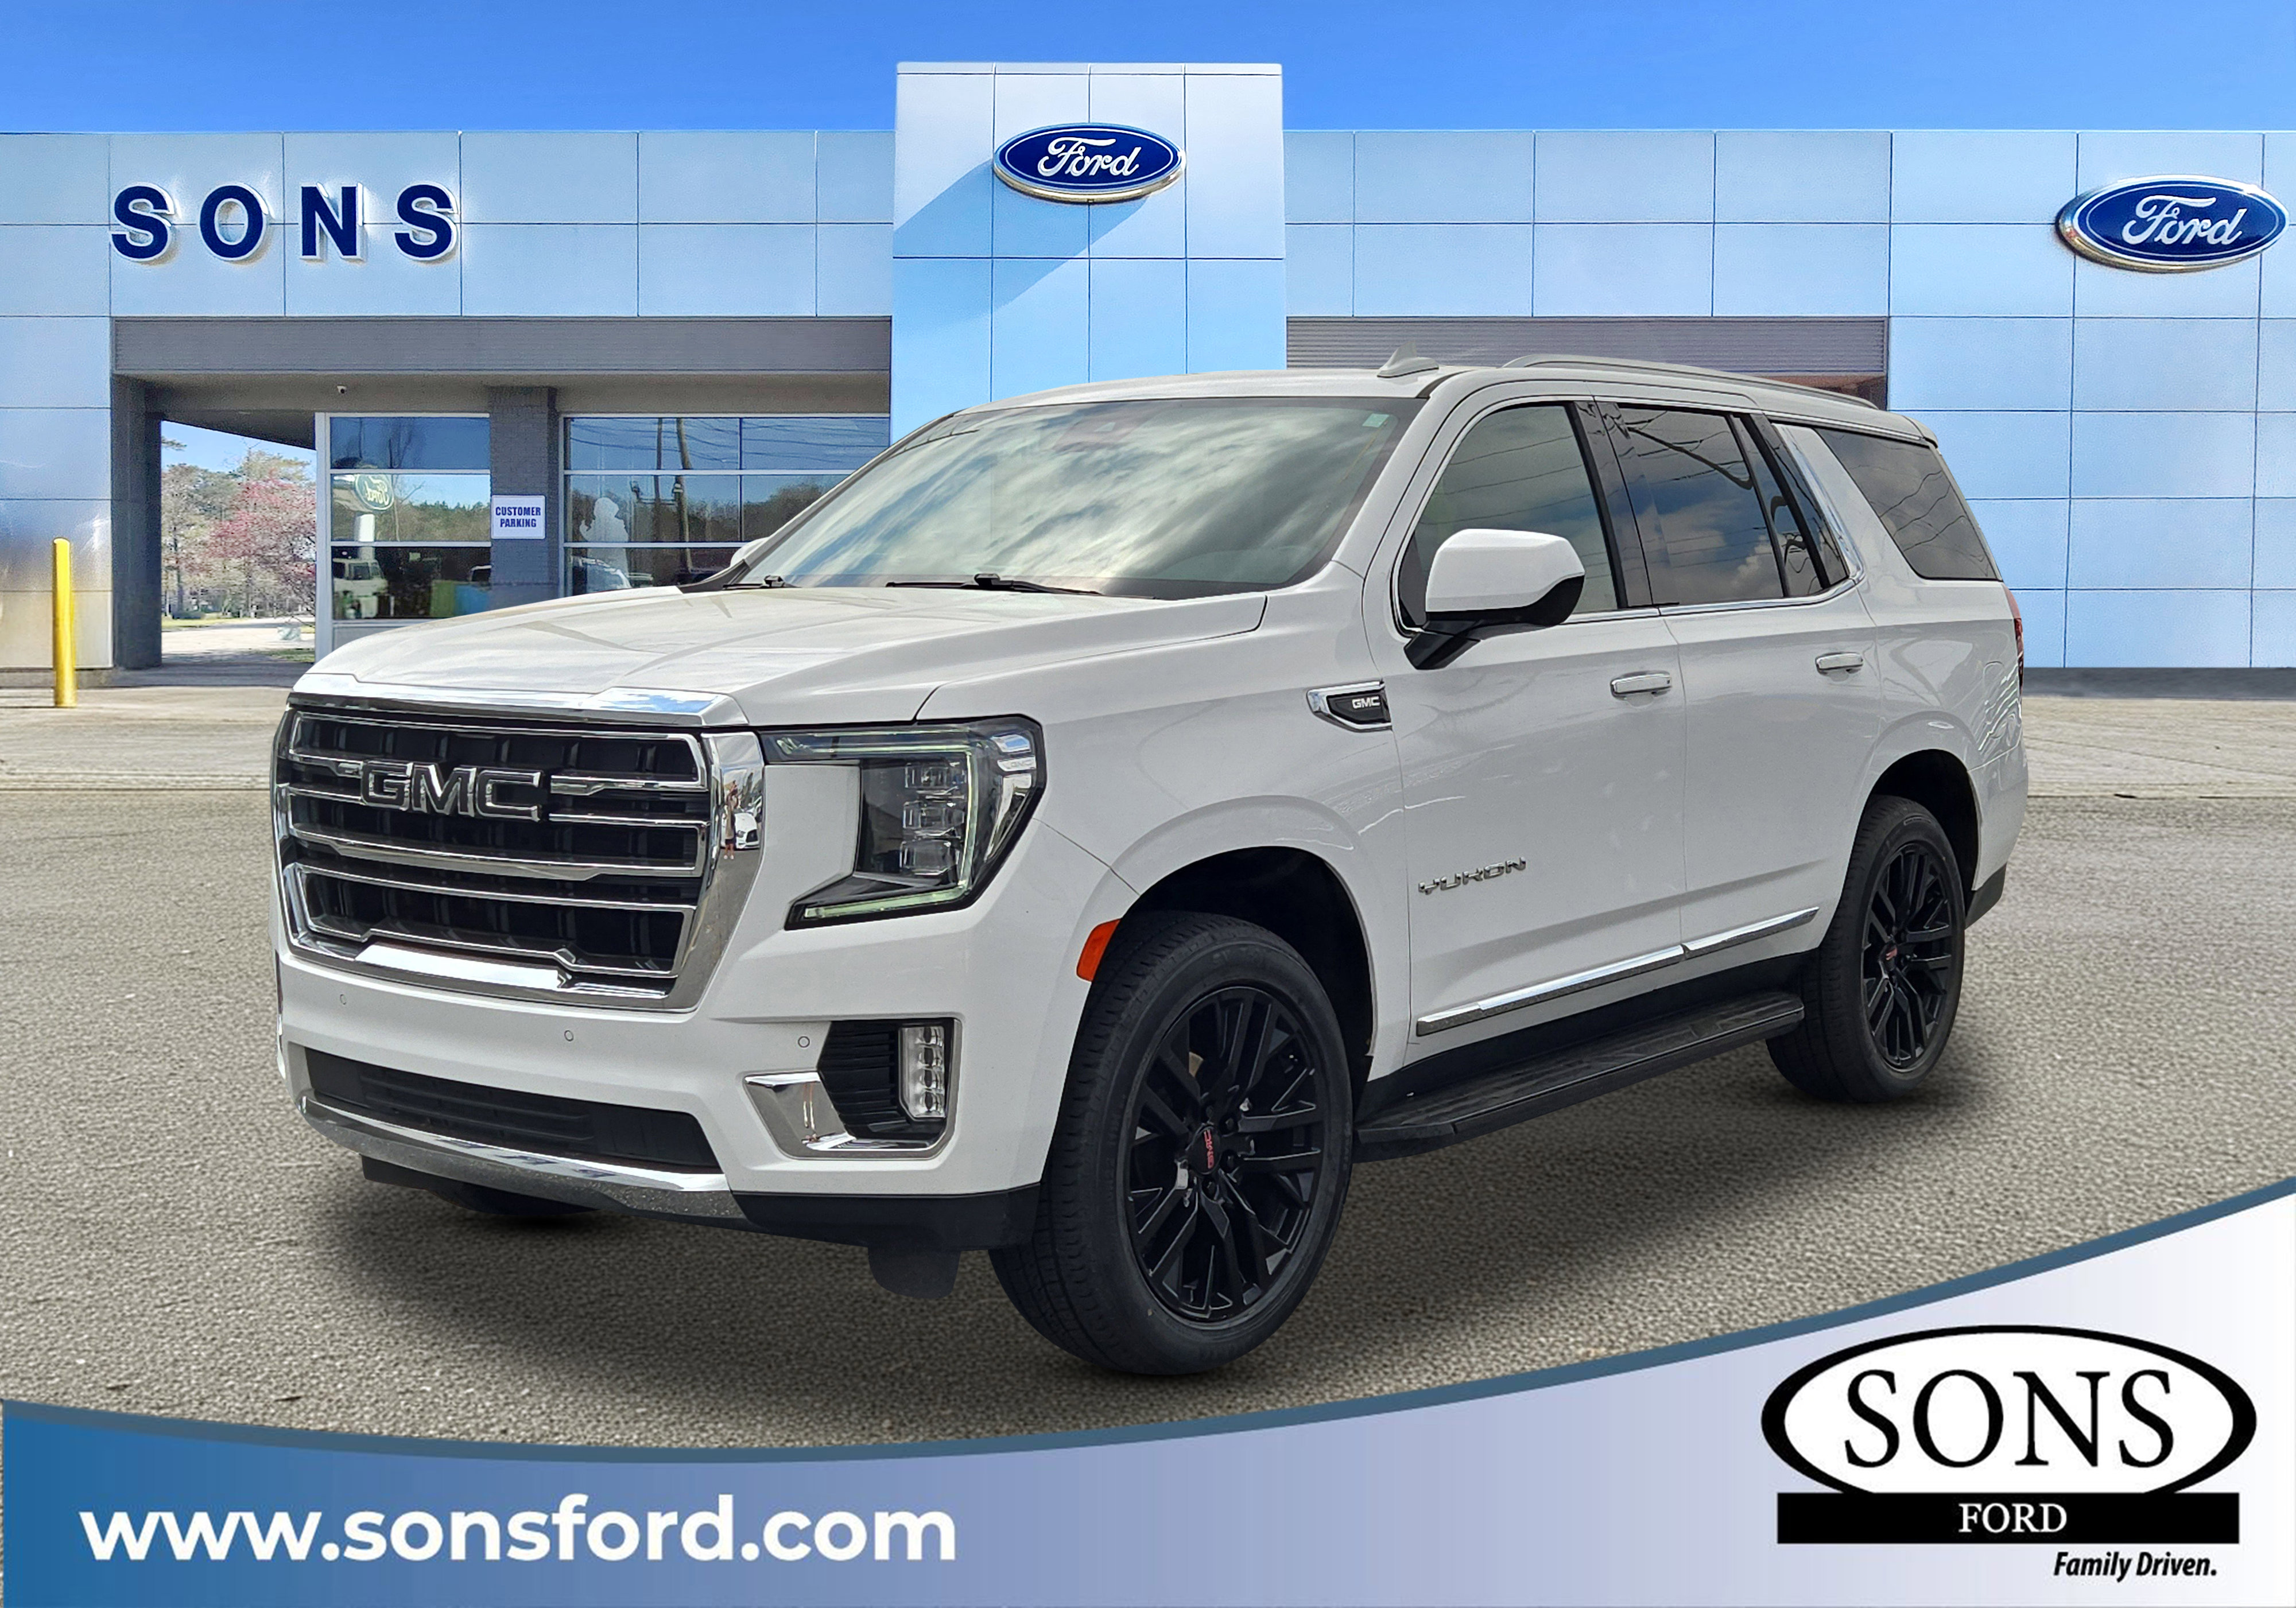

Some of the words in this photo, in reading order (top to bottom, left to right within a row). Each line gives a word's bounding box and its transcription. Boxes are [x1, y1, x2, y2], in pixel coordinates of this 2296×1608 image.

[1038, 137, 1141, 177] Ford
[111, 184, 459, 260] SONS
[2122, 195, 2247, 245] Ford
[495, 507, 541, 515] CUSTOMER
[500, 519, 536, 527] PARKING
[1352, 696, 1380, 708] GMC
[361, 760, 541, 822] GMC
[1418, 857, 1526, 895] YUKON
